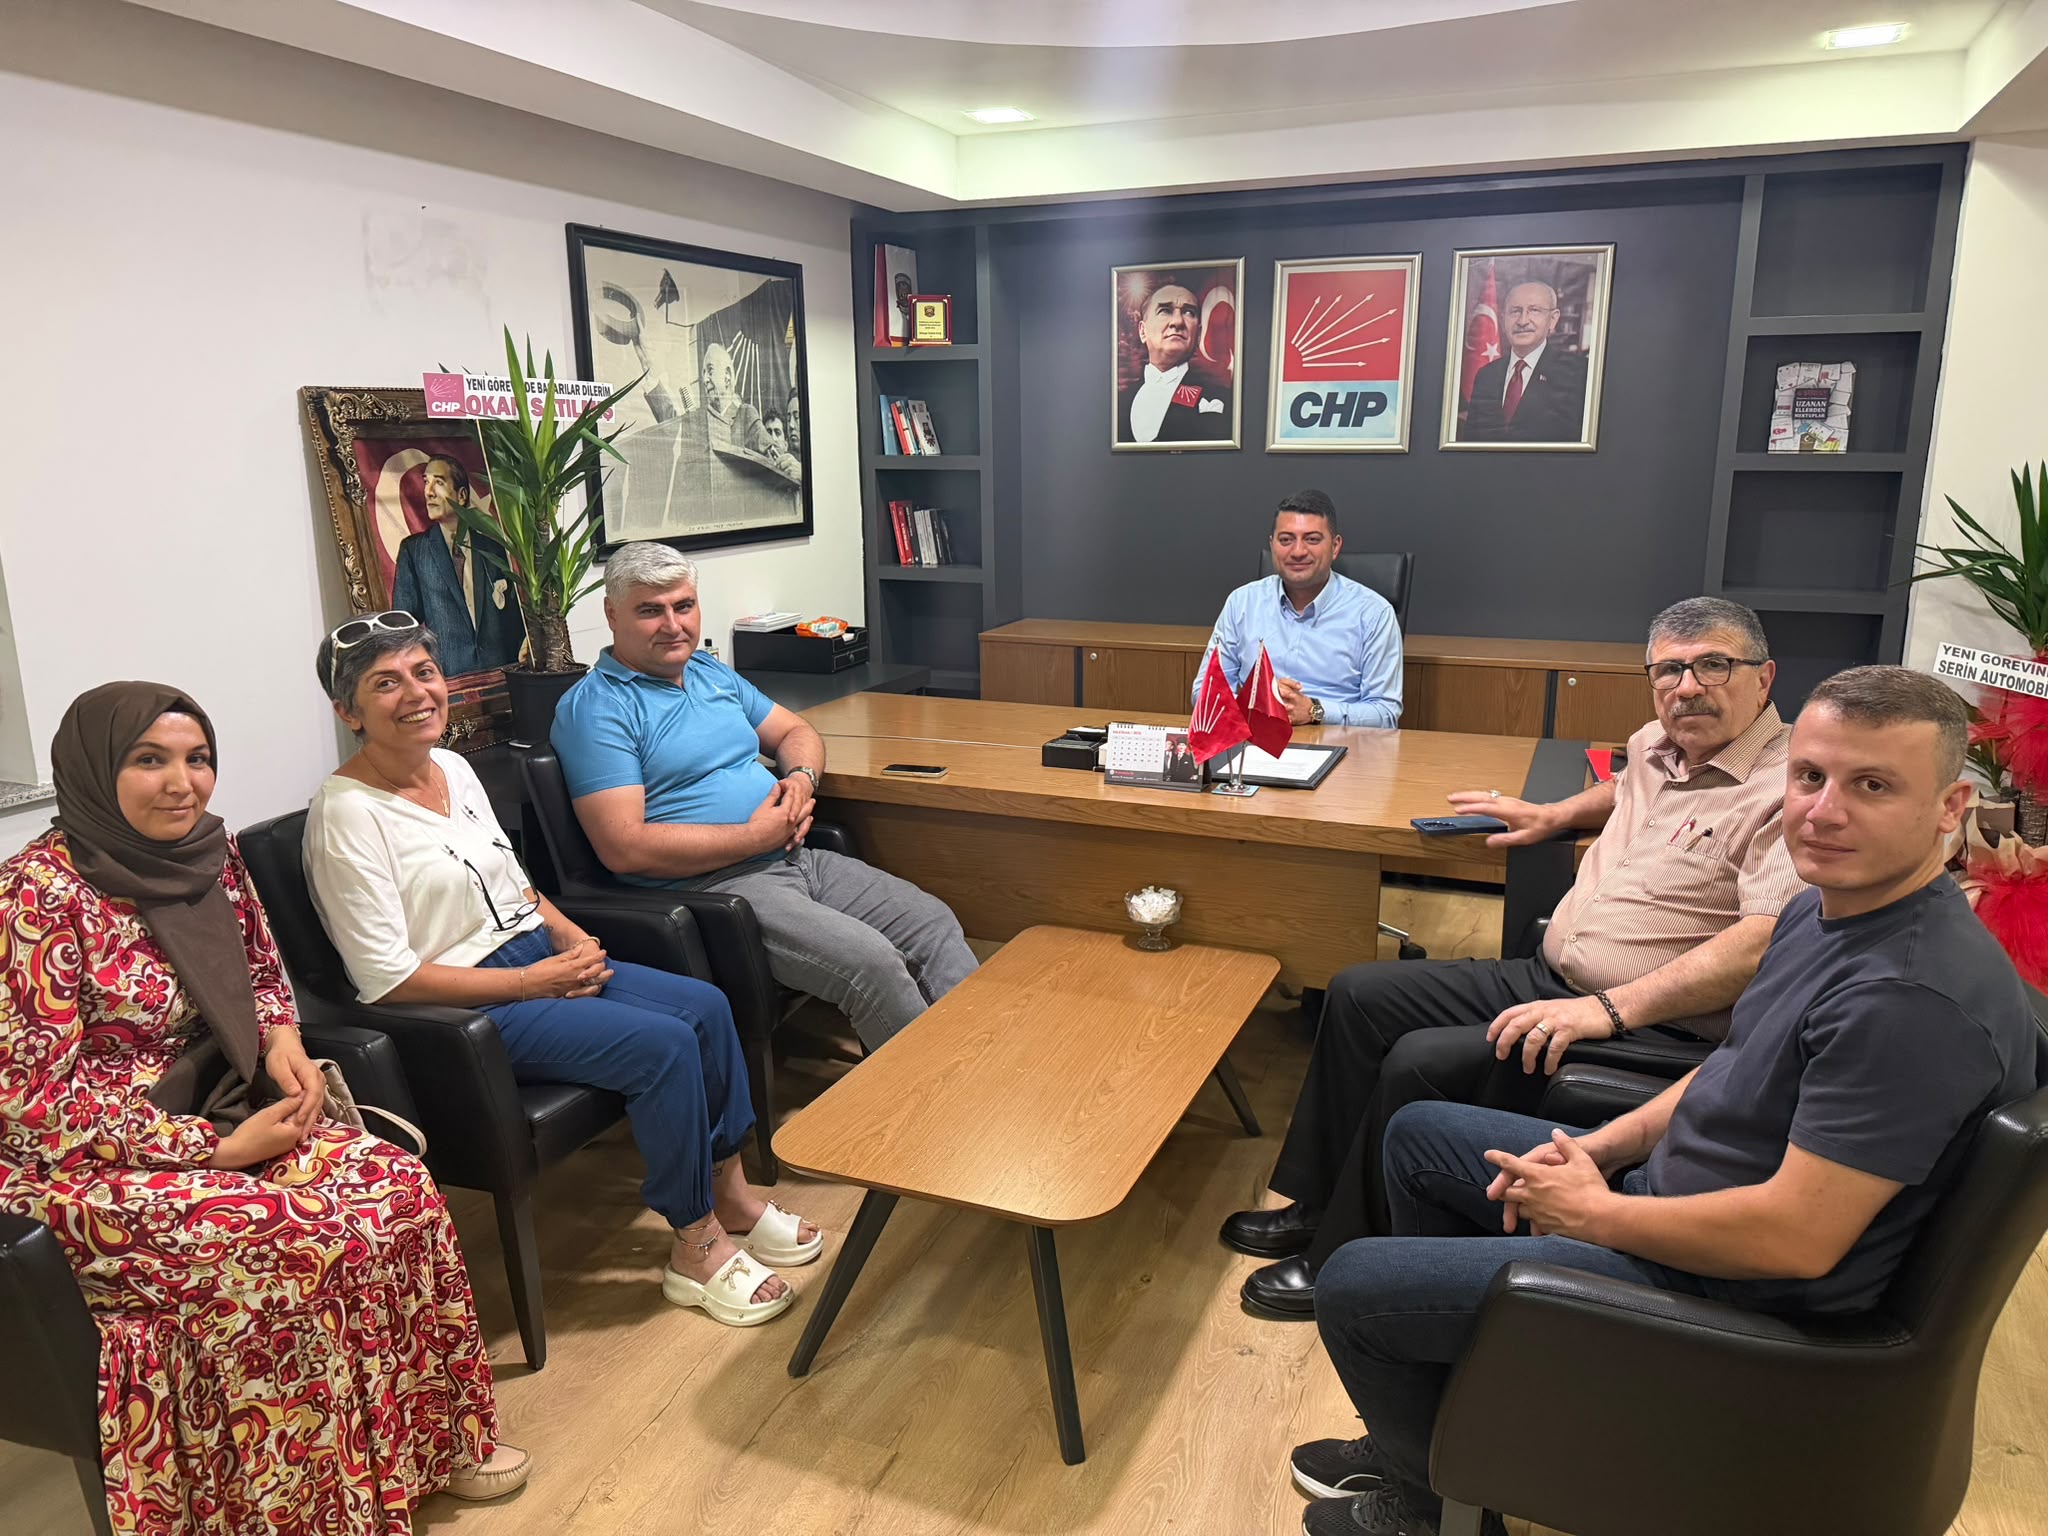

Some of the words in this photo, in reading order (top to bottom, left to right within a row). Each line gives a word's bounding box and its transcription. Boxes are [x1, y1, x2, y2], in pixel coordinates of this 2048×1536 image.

[466, 376, 486, 391] YENİ
[487, 376, 537, 393] GÖREDE
[537, 381, 581, 396] BAARILAR
[582, 382, 611, 397] DİLERİM
[431, 401, 461, 413] CHP
[1290, 391, 1388, 429] CHP
[1795, 400, 1827, 408] UZANAN
[1938, 659, 1978, 681] SERİN
[1980, 653, 2048, 678] GOREVIN
